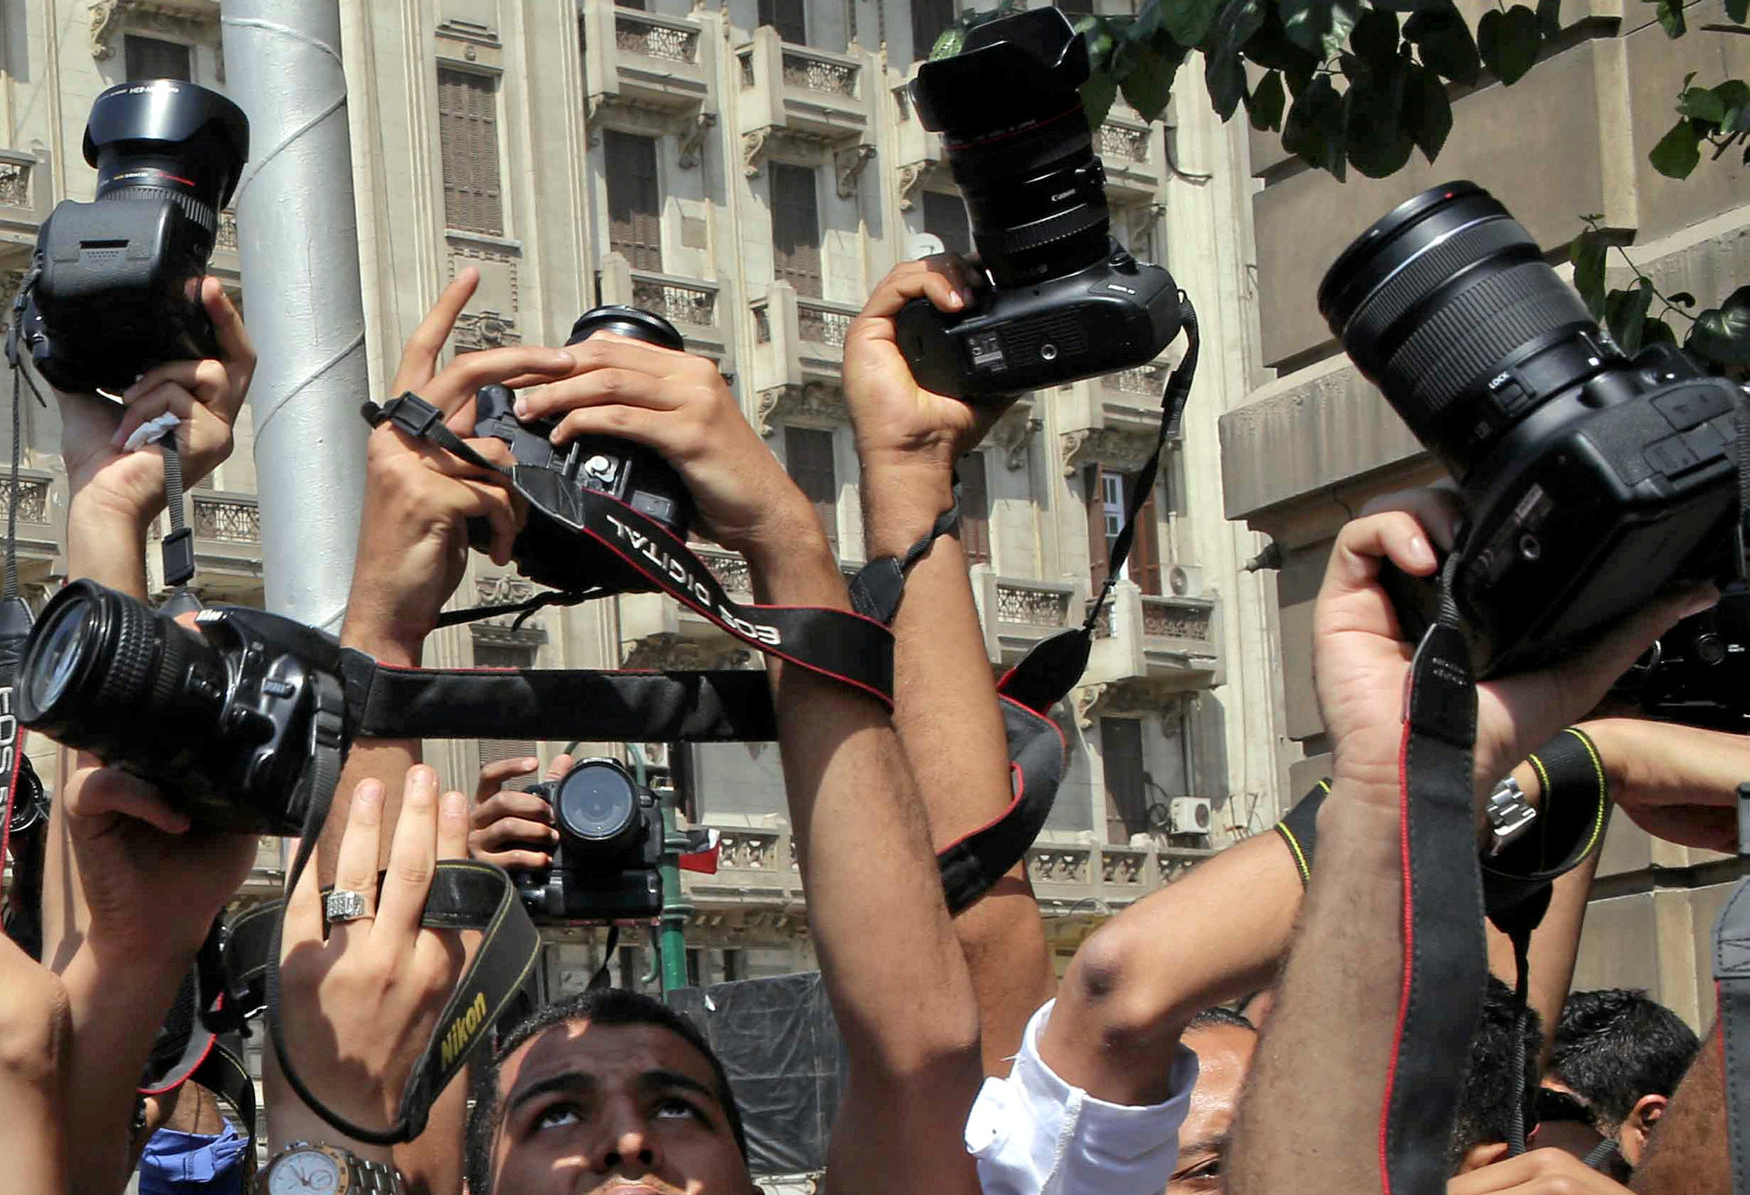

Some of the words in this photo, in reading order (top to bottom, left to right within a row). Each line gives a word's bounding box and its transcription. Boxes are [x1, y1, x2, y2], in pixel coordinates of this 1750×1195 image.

[1488, 371, 1510, 389] LOCK
[606, 514, 711, 606] DIGITAL
[718, 605, 781, 645] EOS
[441, 991, 487, 1072] Nikon
